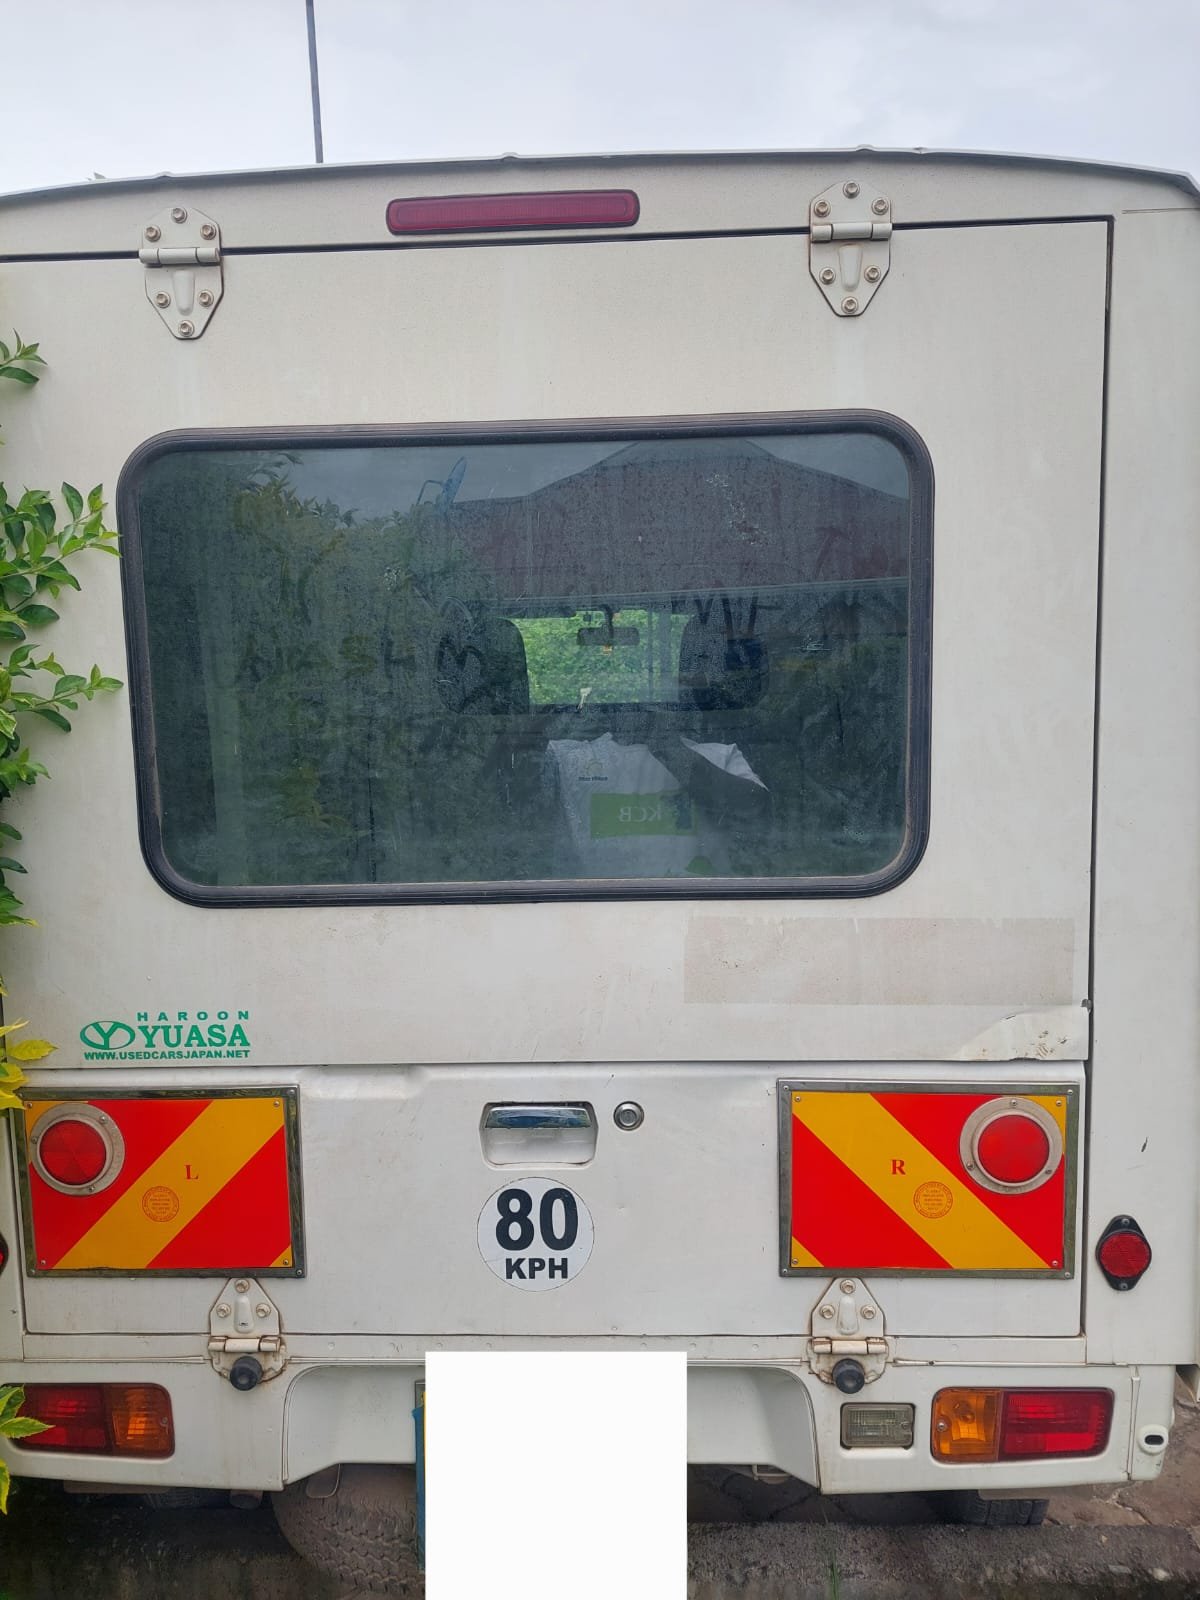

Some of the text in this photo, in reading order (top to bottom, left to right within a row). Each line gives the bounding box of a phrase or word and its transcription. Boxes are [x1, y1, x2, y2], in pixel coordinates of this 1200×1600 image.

[137, 1010, 249, 1022] HAROON
[138, 1023, 250, 1048] YUASA
[84, 1049, 250, 1061] WWW.USEDCARSJAPAN.NET
[184, 1164, 199, 1180] L
[892, 1159, 906, 1175] R
[495, 1187, 579, 1251] 80
[505, 1257, 569, 1279] KPH
